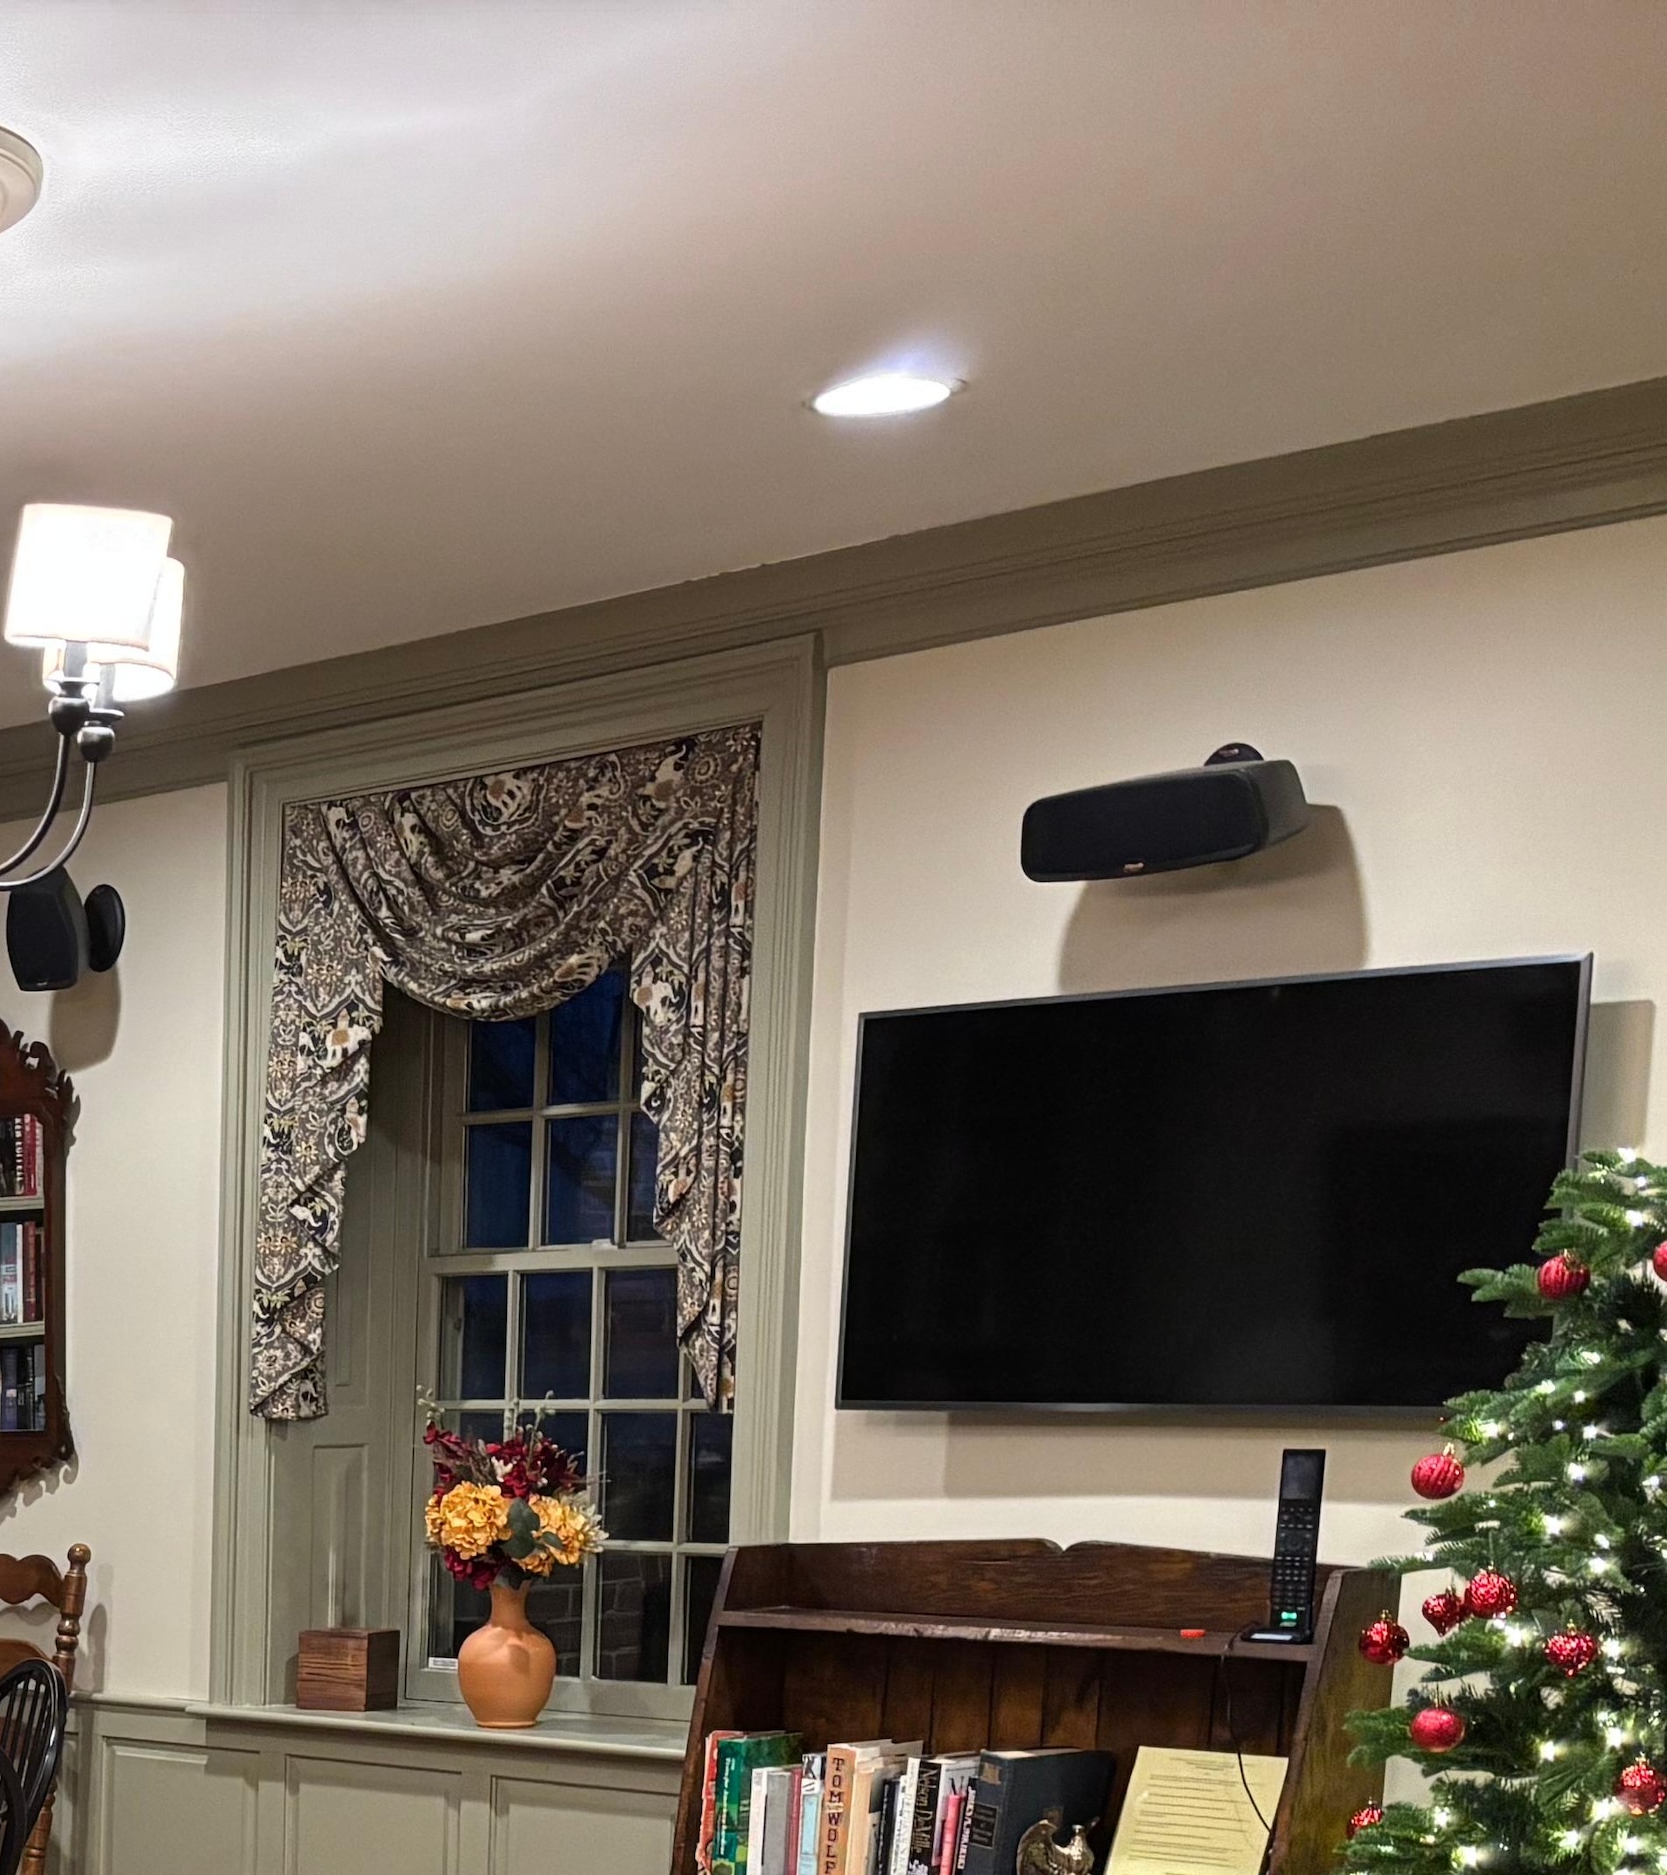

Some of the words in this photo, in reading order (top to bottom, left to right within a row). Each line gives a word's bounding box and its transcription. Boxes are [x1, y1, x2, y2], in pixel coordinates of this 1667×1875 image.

[828, 1757, 846, 1805] TOM
[916, 1768, 938, 1807] Nelson
[910, 1809, 933, 1853] DeMille
